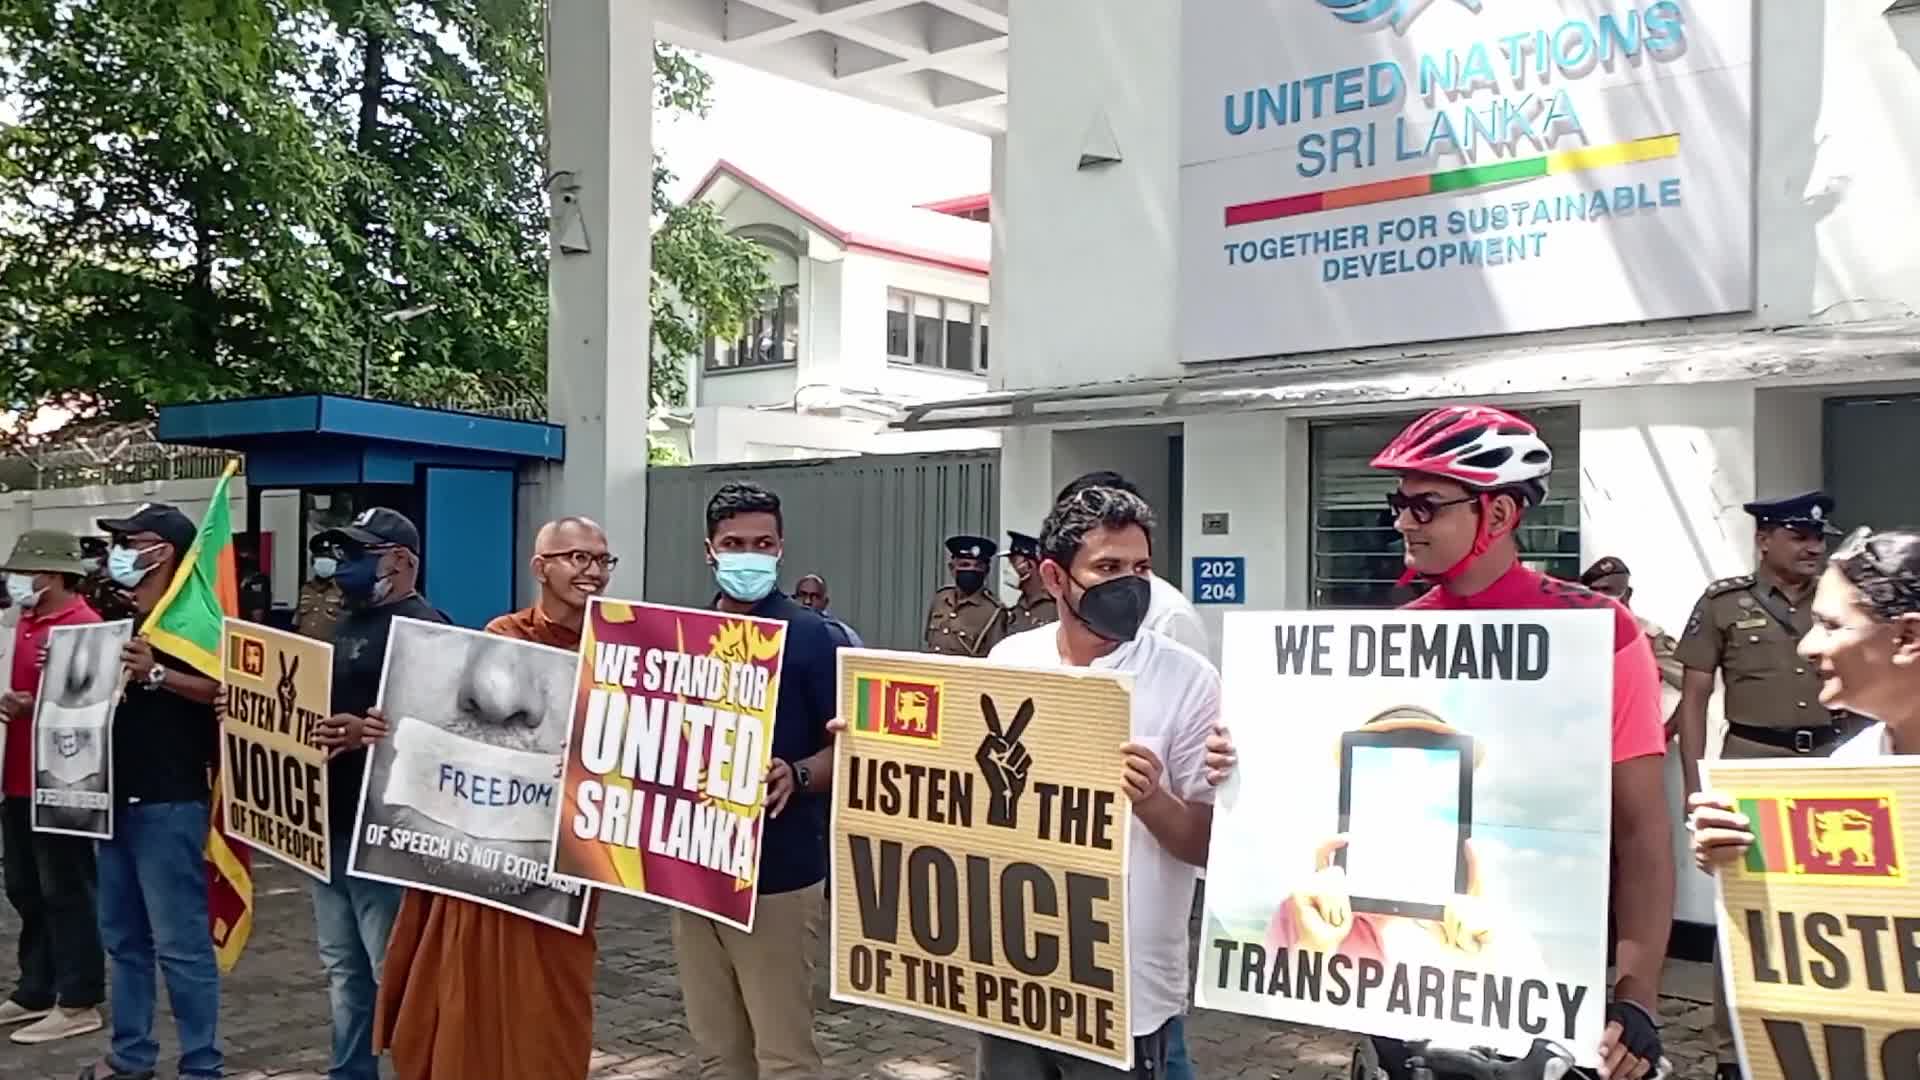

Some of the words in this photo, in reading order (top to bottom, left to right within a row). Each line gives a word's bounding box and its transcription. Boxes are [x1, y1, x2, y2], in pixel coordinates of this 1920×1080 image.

[1226, 61, 1402, 136] UNITED
[1420, 0, 1685, 96] NATIONS
[1296, 124, 1376, 179] SRI
[1396, 88, 1582, 161] LANKA
[1225, 226, 1368, 266] TOGETHER
[1378, 216, 1438, 244] FOR
[1448, 178, 1681, 234] SUSTAINABLE
[1323, 232, 1546, 282] DEVELOPMENT
[1200, 562, 1235, 578] 202
[1200, 583, 1235, 600] 204
[594, 641, 641, 688] WE
[643, 649, 720, 700] STAND
[728, 664, 769, 711] FOR
[1275, 624, 1334, 676] WE
[1348, 623, 1550, 681] DEMAND
[227, 684, 276, 733] LISTEN
[580, 689, 765, 807] UNITED
[227, 733, 323, 835] VOICE
[439, 764, 553, 806] FREEDOM
[848, 756, 974, 828] LISTEN
[1034, 782, 1114, 850] THE
[231, 804, 249, 833] OF
[250, 810, 275, 844] THE
[276, 826, 325, 870] PEOPLE
[366, 823, 388, 846] OF
[389, 828, 450, 859] SPEECH
[452, 842, 469, 863] IS
[470, 848, 501, 872] NOT
[573, 780, 641, 849] SRI
[649, 797, 756, 882] LANKA
[848, 834, 1114, 993] VOICE
[850, 945, 892, 994] OF
[900, 954, 967, 1014] THE
[975, 971, 1114, 1050] PEOPLE
[1213, 939, 1588, 1040] TRANSPARENCY
